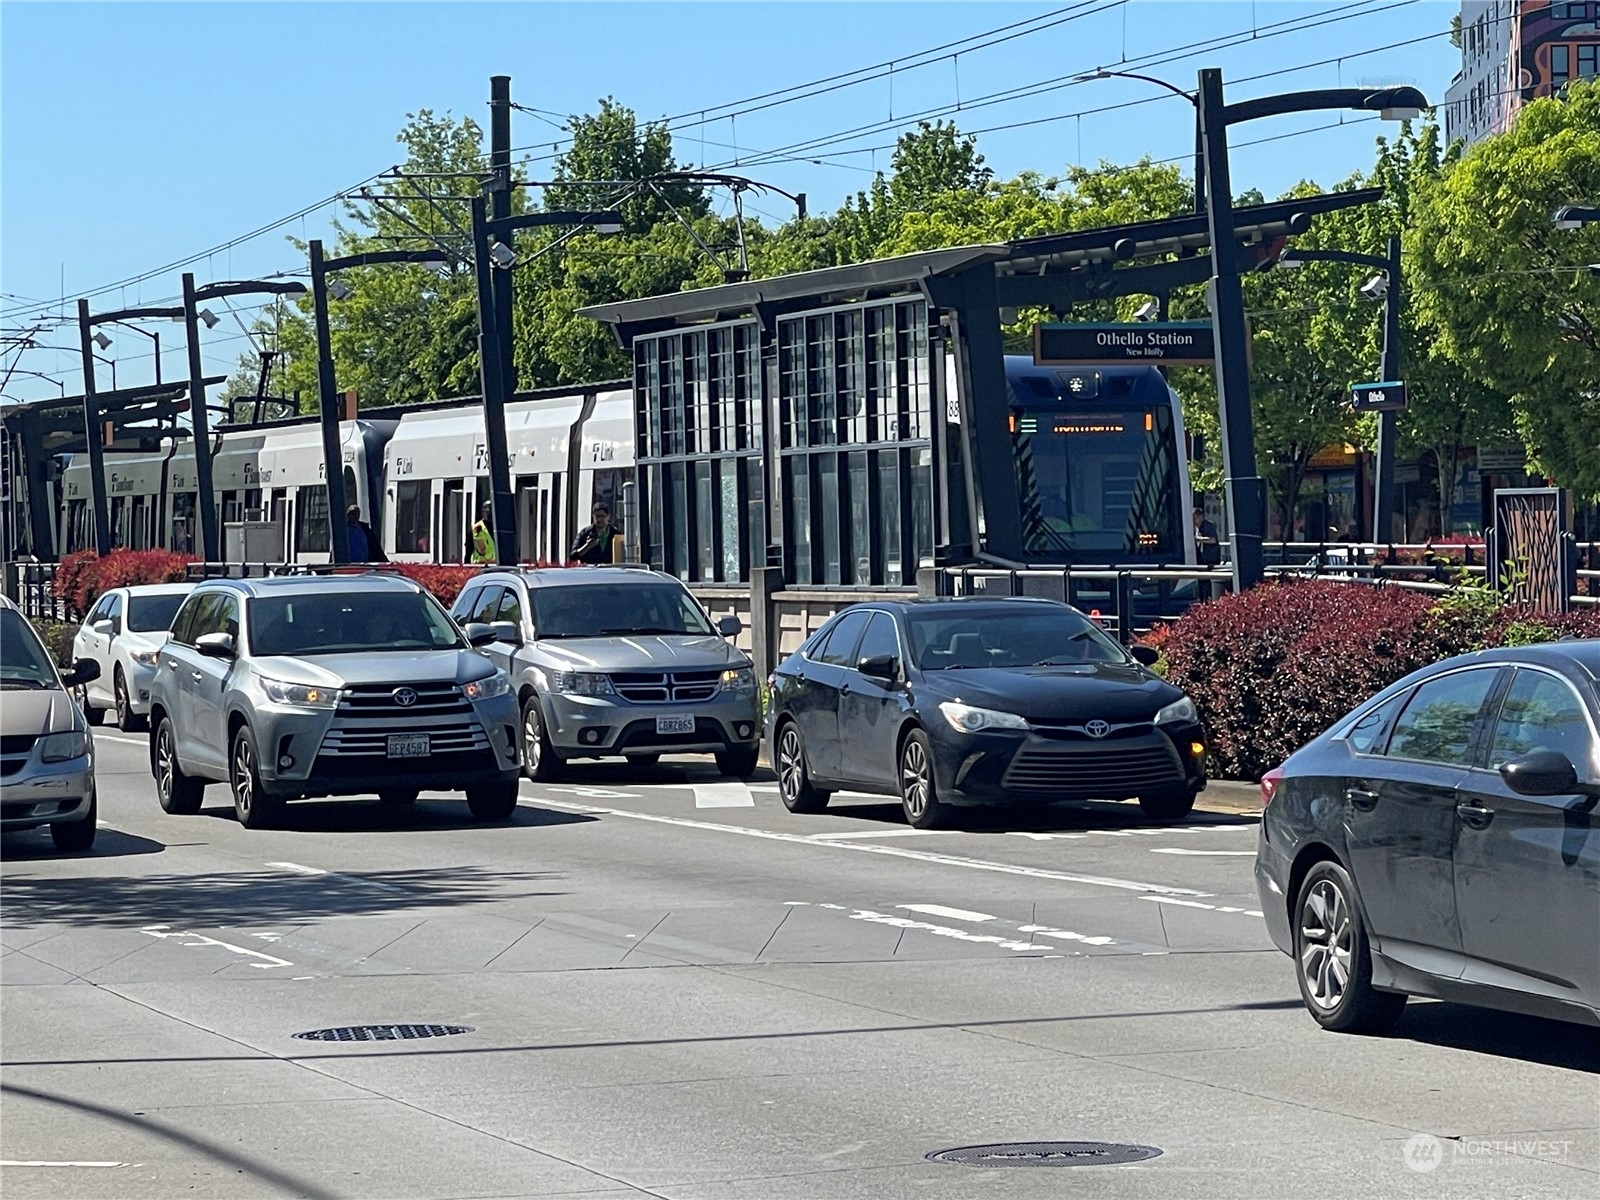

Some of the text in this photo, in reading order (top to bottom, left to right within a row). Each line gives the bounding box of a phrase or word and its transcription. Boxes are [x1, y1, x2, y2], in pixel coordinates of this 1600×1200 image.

[1097, 332, 1193, 345] Othello Station
[1126, 347, 1164, 358] New Holly
